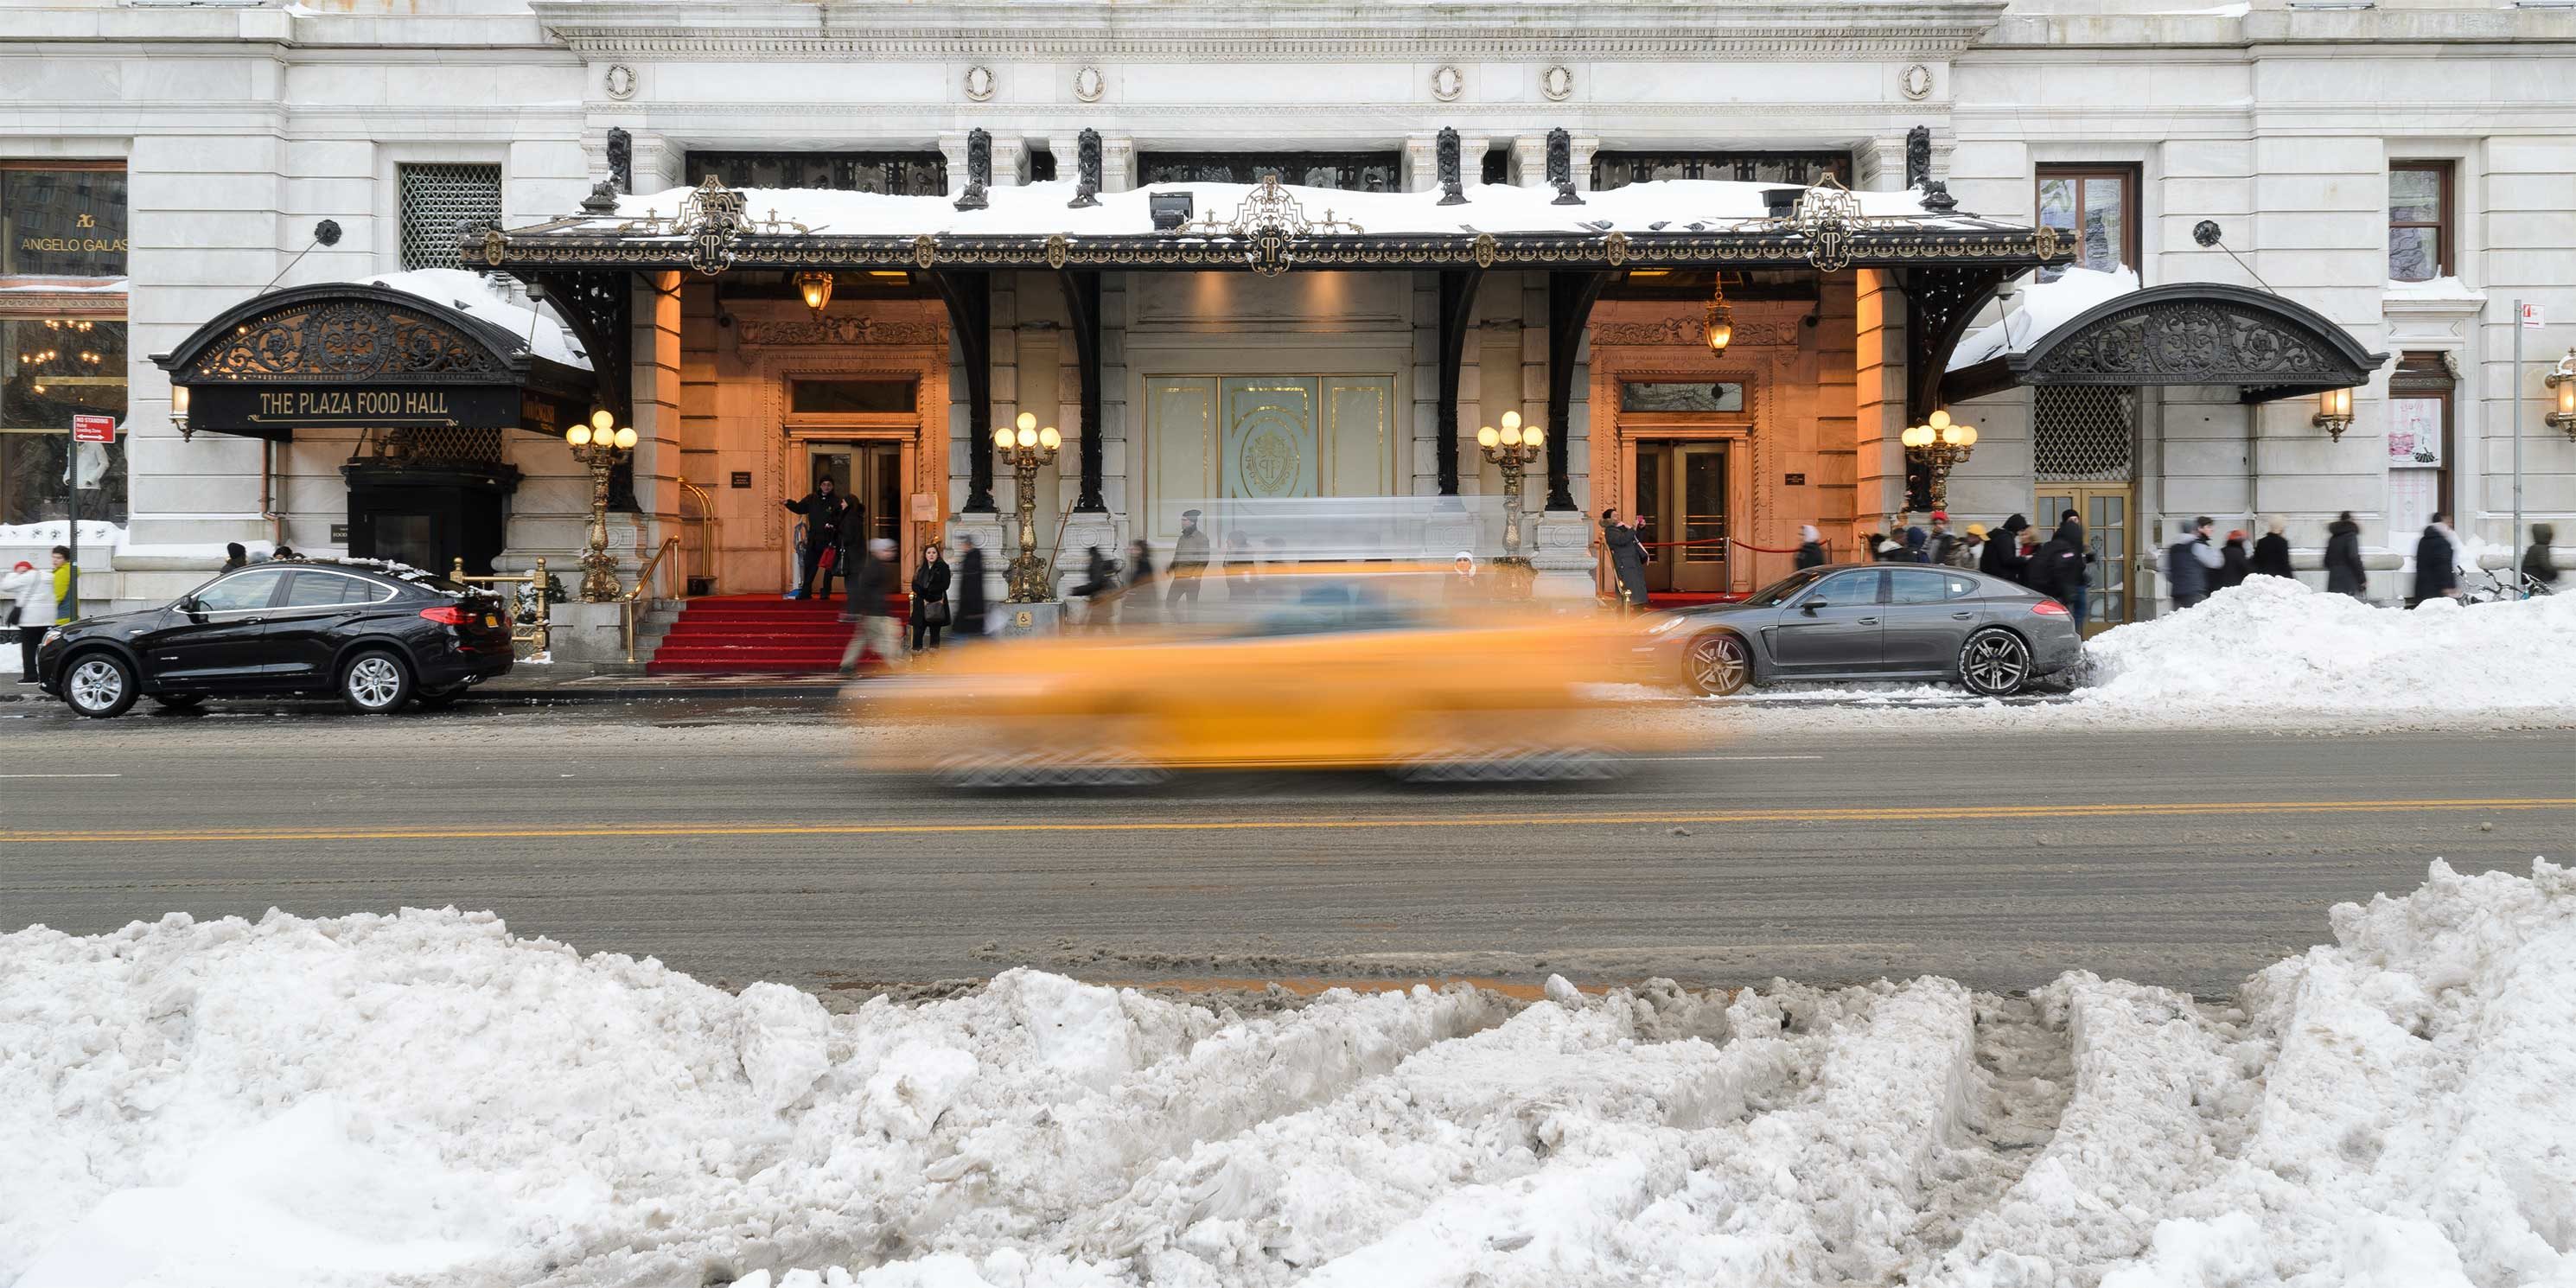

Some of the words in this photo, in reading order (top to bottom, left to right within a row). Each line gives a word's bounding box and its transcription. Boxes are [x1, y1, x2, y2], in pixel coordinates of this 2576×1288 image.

[22, 239, 80, 251] ANGELO
[260, 392, 294, 414] THE
[299, 392, 353, 414] PLAZA
[357, 392, 400, 413] FOOD
[405, 392, 448, 413] HALL
